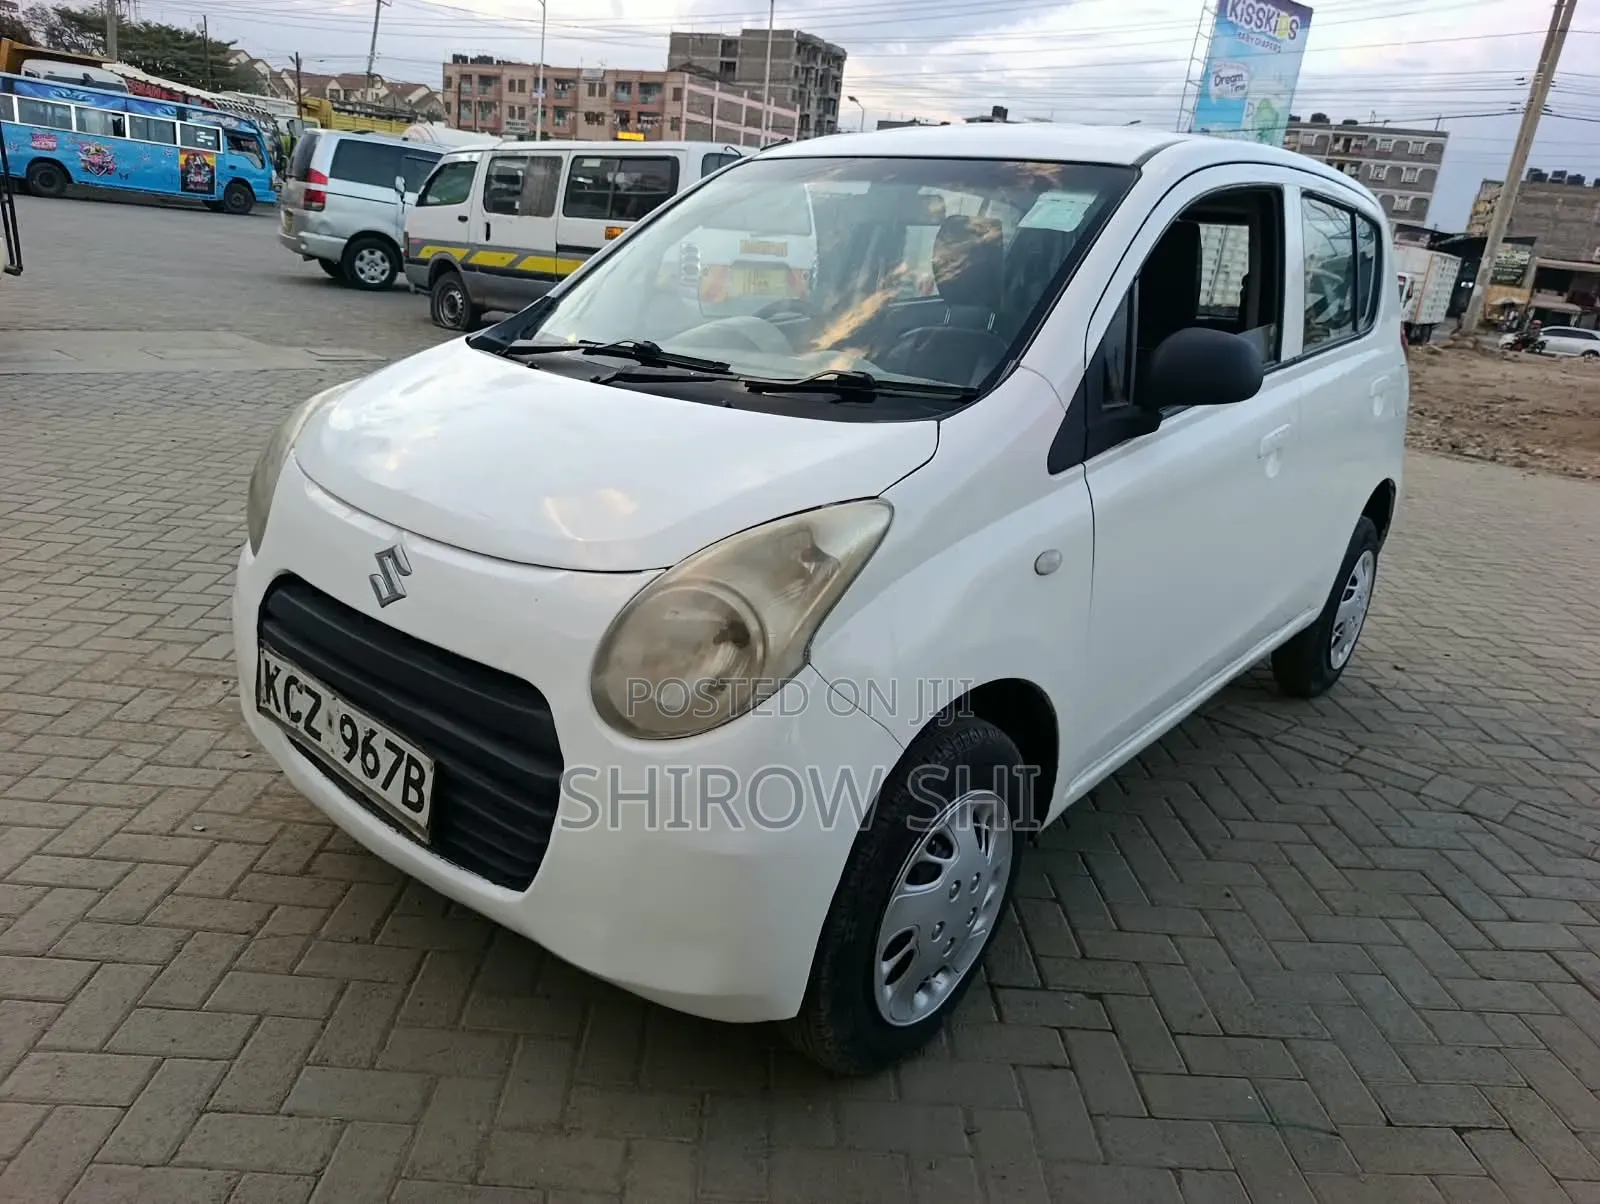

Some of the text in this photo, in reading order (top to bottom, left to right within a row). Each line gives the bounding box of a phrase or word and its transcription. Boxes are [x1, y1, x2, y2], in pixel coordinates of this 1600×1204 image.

[1214, 73, 1243, 87] Dream
[264, 659, 426, 814] KCZ 967B
